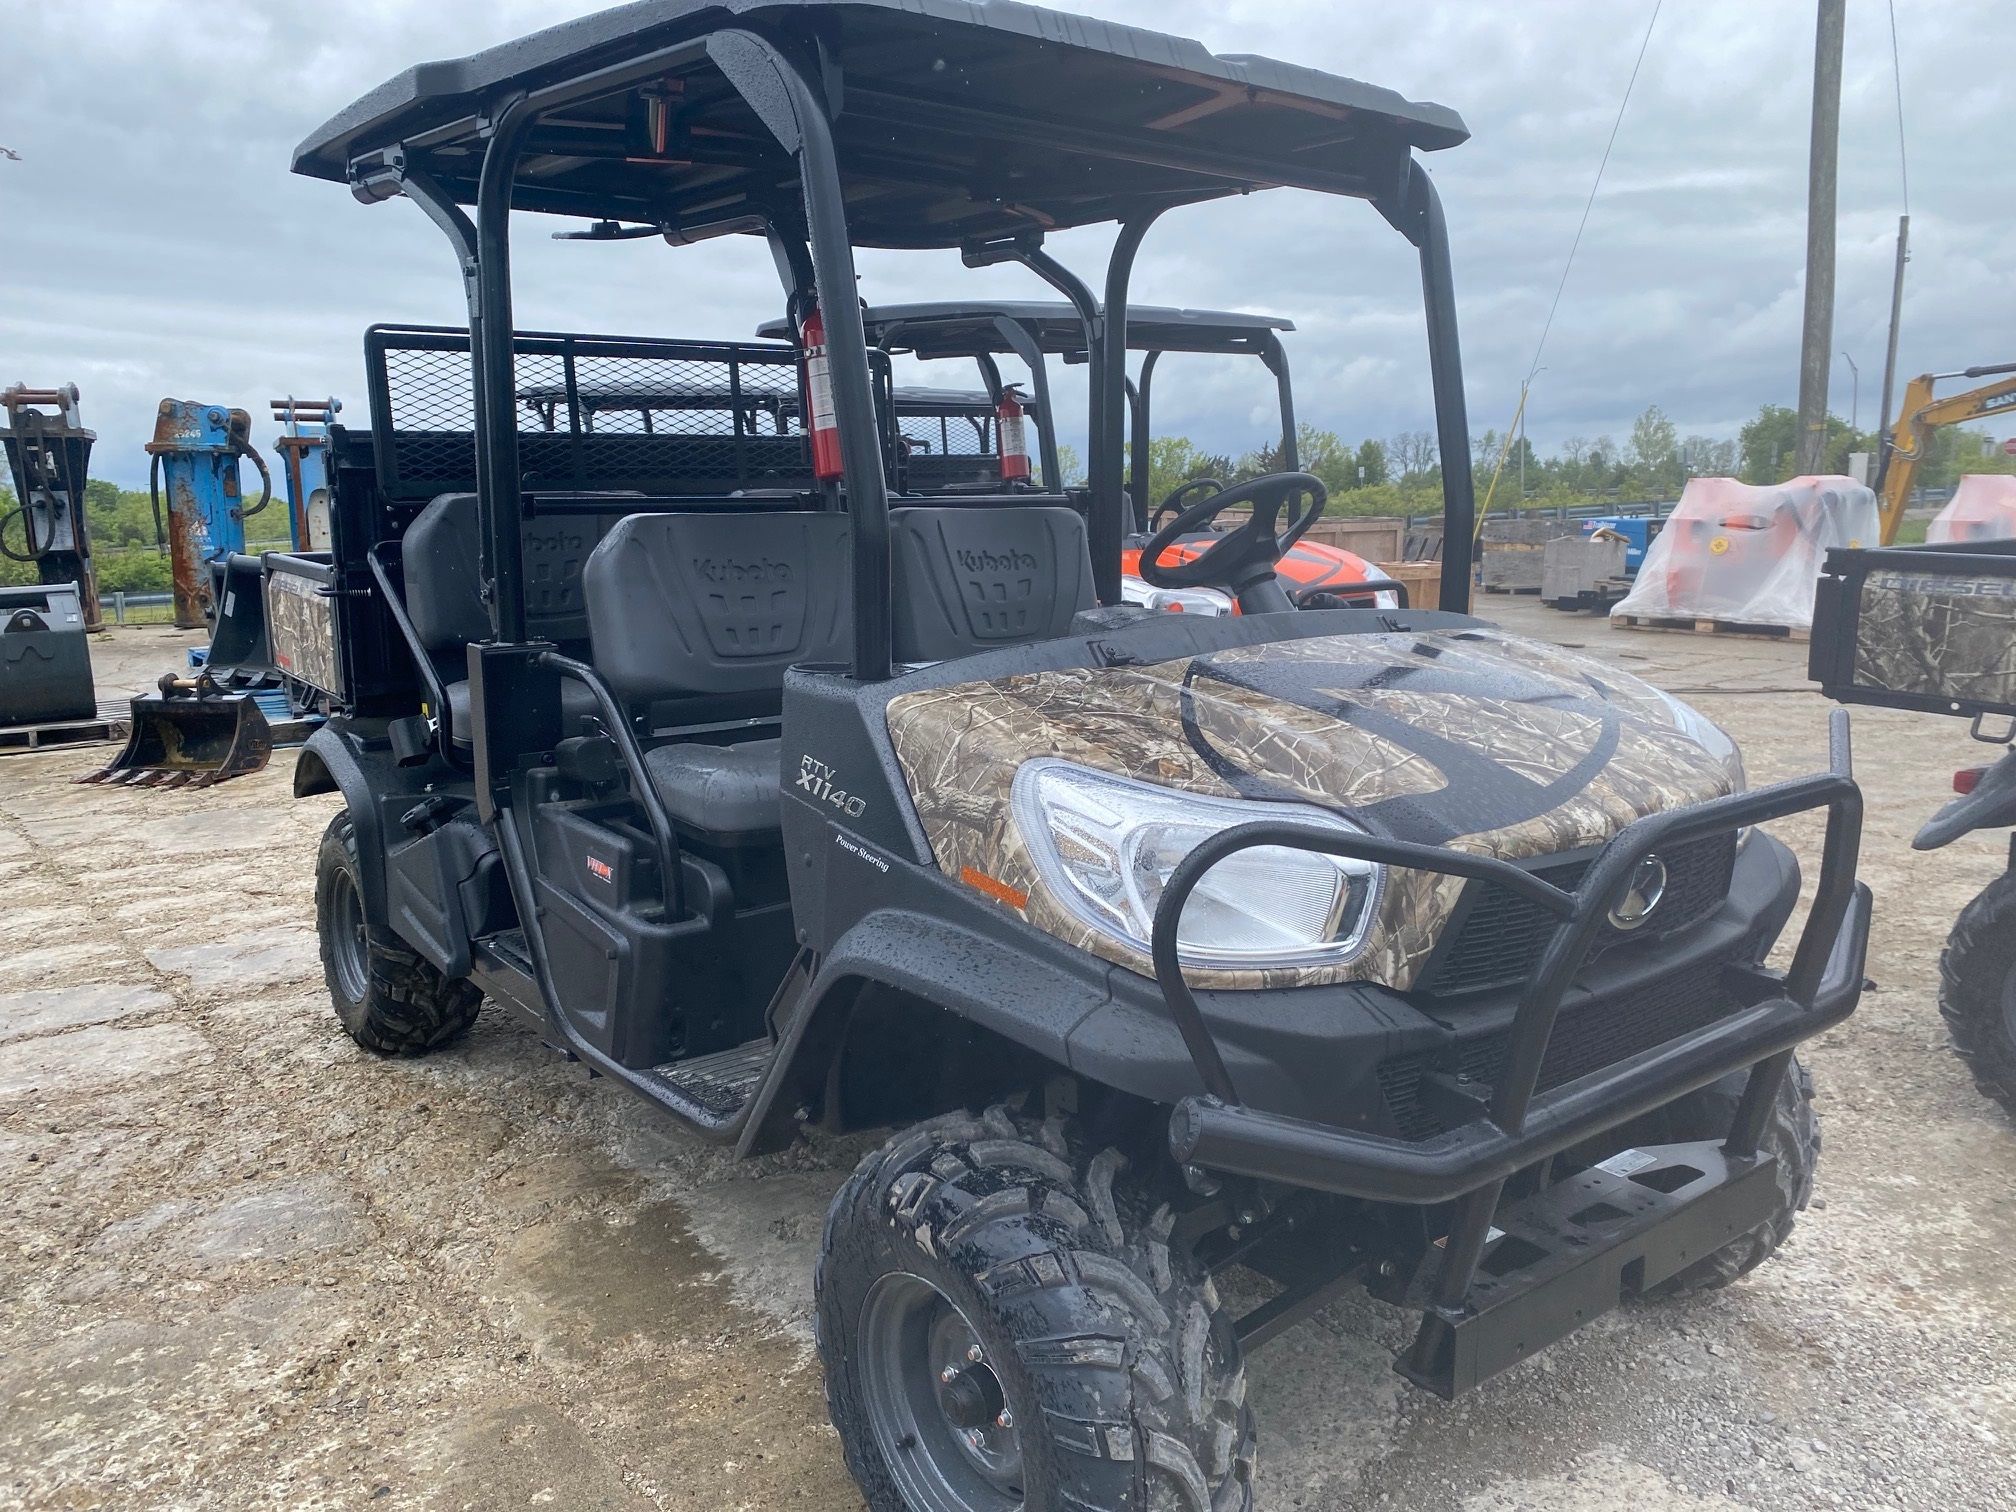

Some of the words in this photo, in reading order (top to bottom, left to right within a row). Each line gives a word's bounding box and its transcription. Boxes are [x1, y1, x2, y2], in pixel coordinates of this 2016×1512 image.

[1985, 392, 2016, 409] SAN
[520, 530, 583, 551] bota
[692, 557, 793, 583] Kubota
[956, 548, 1037, 572] Kubota
[801, 754, 836, 780] RTV
[795, 768, 867, 818] X1140
[835, 834, 859, 854] Power
[857, 846, 891, 874] Steering
